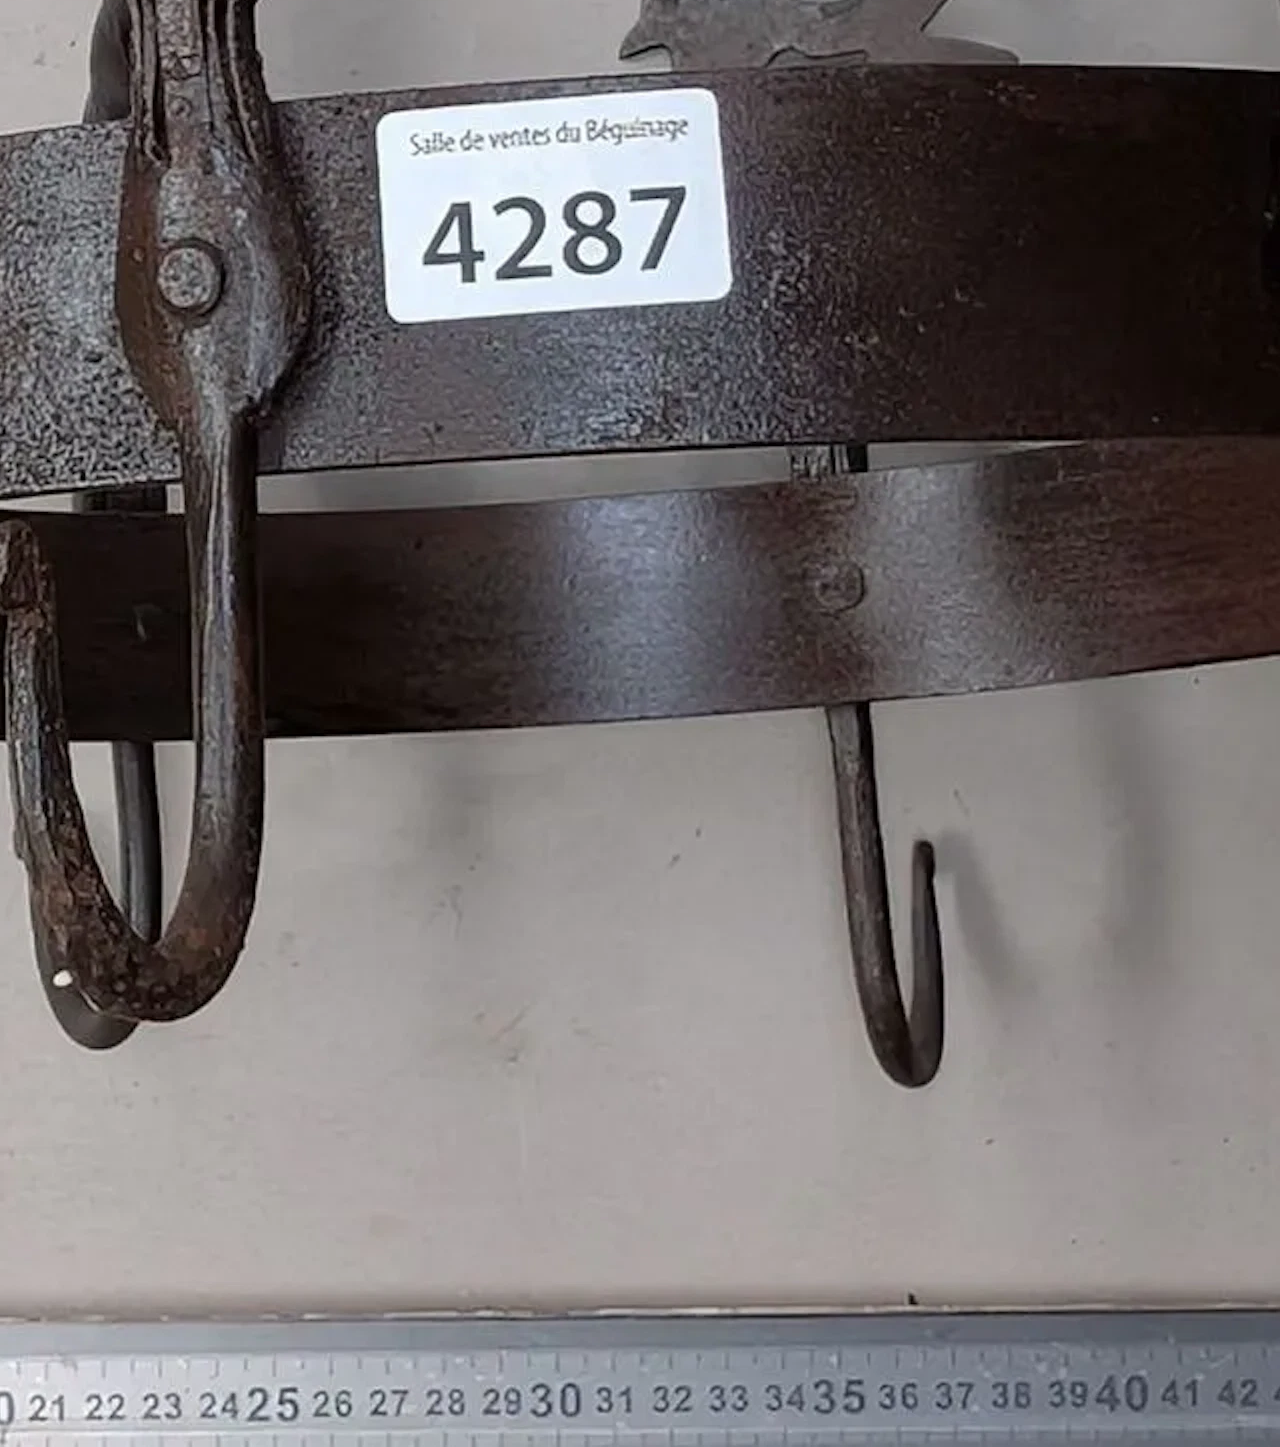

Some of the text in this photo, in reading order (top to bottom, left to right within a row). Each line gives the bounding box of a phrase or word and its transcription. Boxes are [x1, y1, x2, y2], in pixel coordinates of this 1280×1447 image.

[410, 117, 688, 155] Salle de ventes du Béguinage
[423, 185, 686, 284] 4287
[28, 1394, 64, 1422] 21
[84, 1394, 126, 1421] 22
[141, 1393, 182, 1420] 23
[200, 1392, 239, 1419] 24
[246, 1387, 299, 1422] 25
[313, 1390, 352, 1418] 26
[370, 1389, 409, 1417] 27
[426, 1389, 465, 1416] 28
[483, 1387, 521, 1415] 29
[530, 1383, 581, 1418] 30
[596, 1387, 631, 1413] 31
[653, 1386, 692, 1413] 32
[710, 1385, 749, 1413] 33
[765, 1384, 805, 1412] 34
[814, 1379, 865, 1415] 35
[879, 1383, 918, 1411] 36
[936, 1382, 974, 1410] 37
[992, 1382, 1031, 1409] 38
[1049, 1380, 1089, 1409] 39
[1094, 1375, 1148, 1412] 40
[1161, 1379, 1197, 1407] 41
[1217, 1379, 1259, 1408] 42
